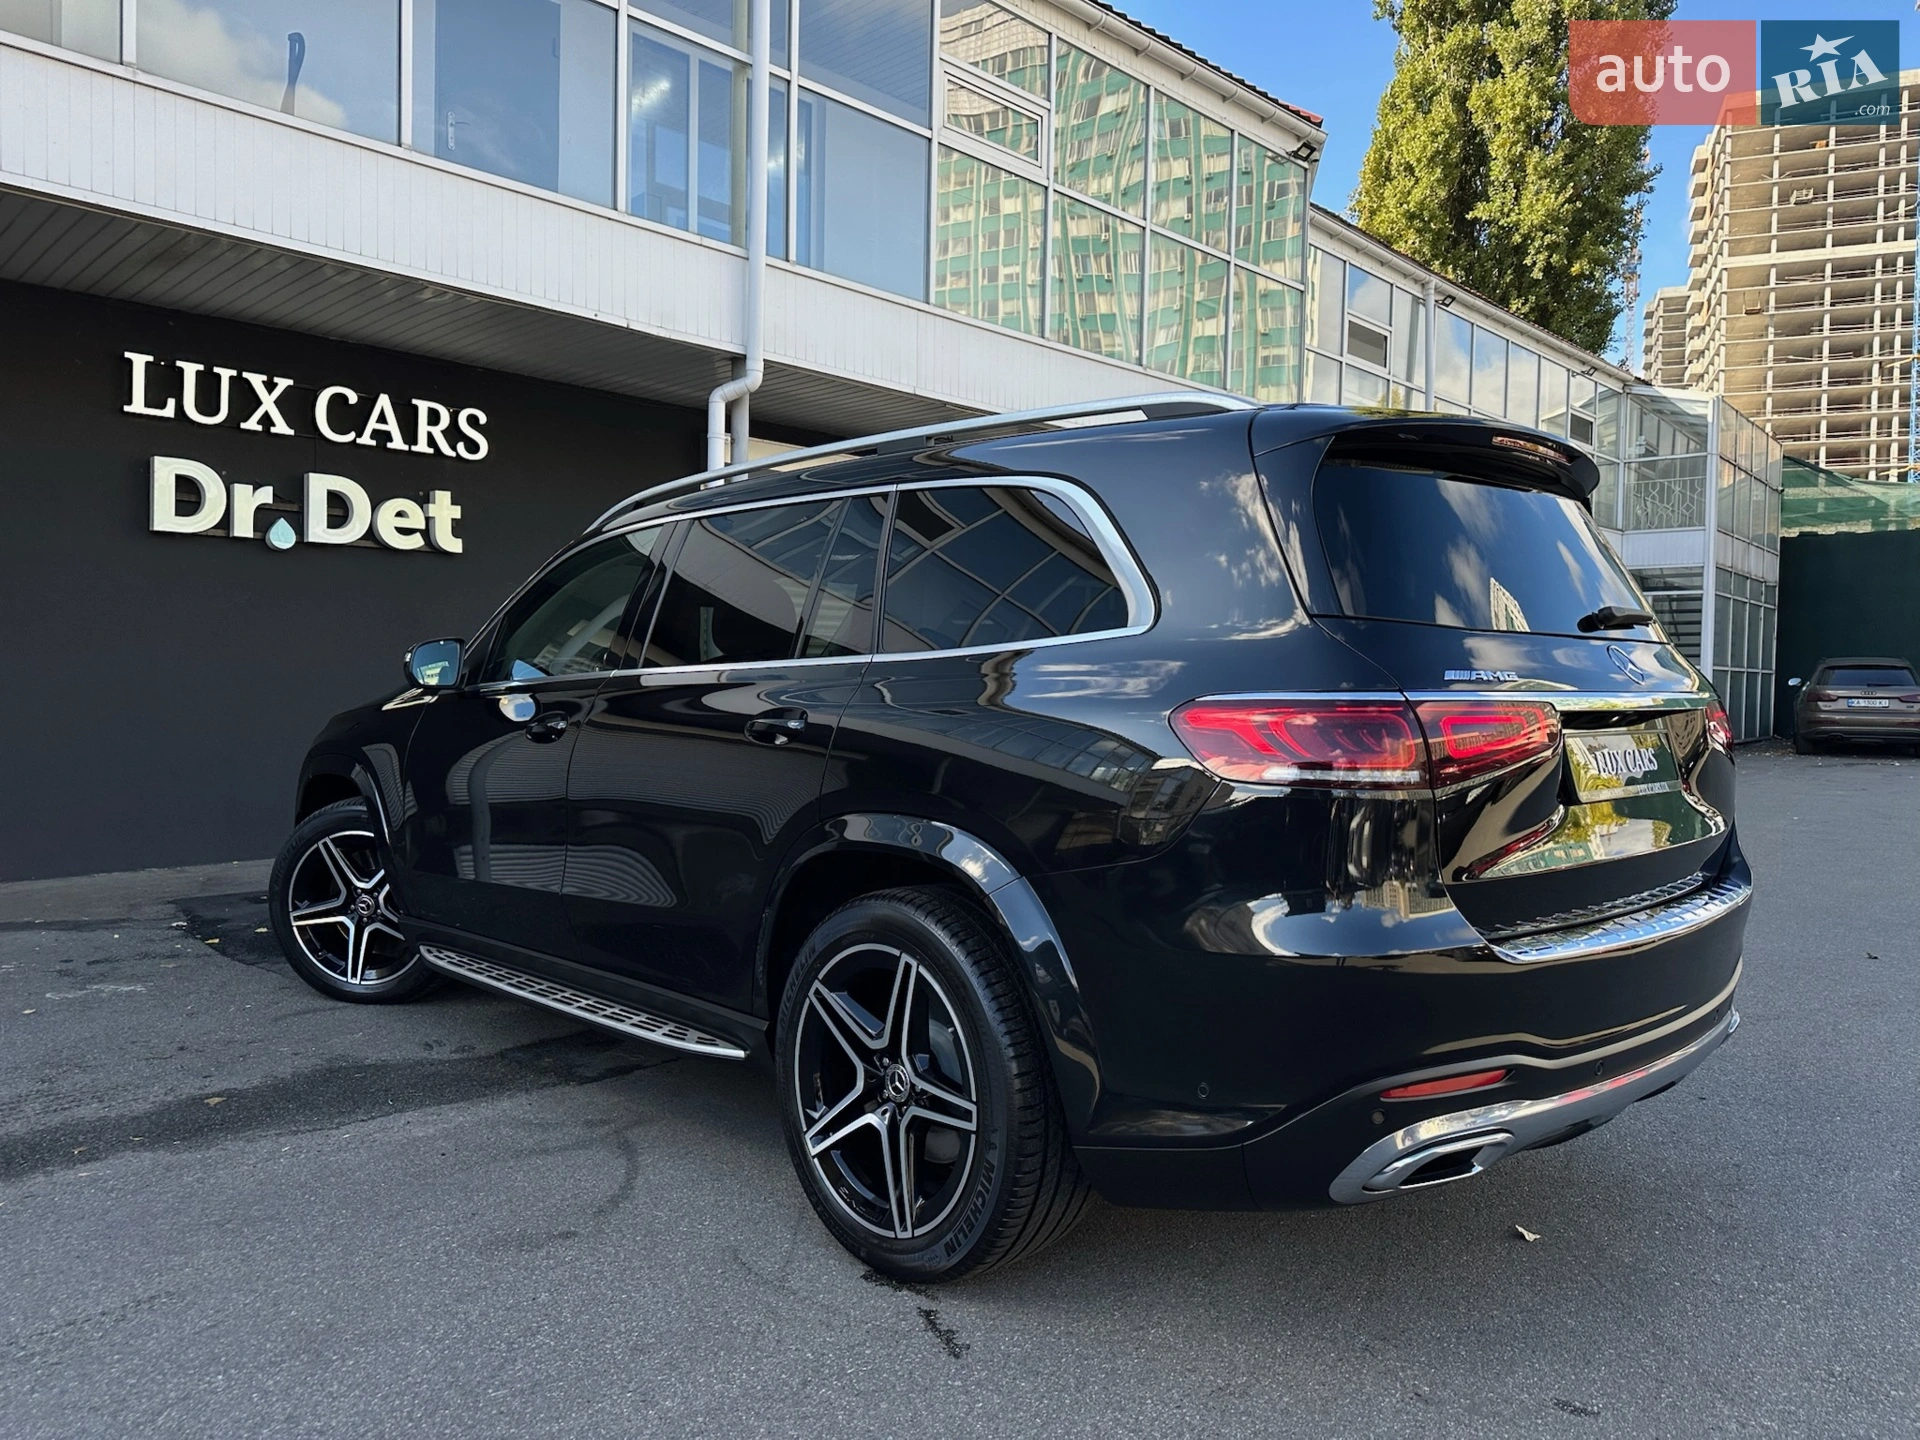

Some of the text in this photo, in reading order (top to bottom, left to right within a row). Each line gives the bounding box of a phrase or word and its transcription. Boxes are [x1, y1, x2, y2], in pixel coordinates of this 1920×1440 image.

[123, 351, 489, 461] LUX CARS
[1470, 670, 1520, 682] AMG
[1595, 747, 1658, 775] LUX CARS
[943, 1158, 996, 1258] MICHELIN
